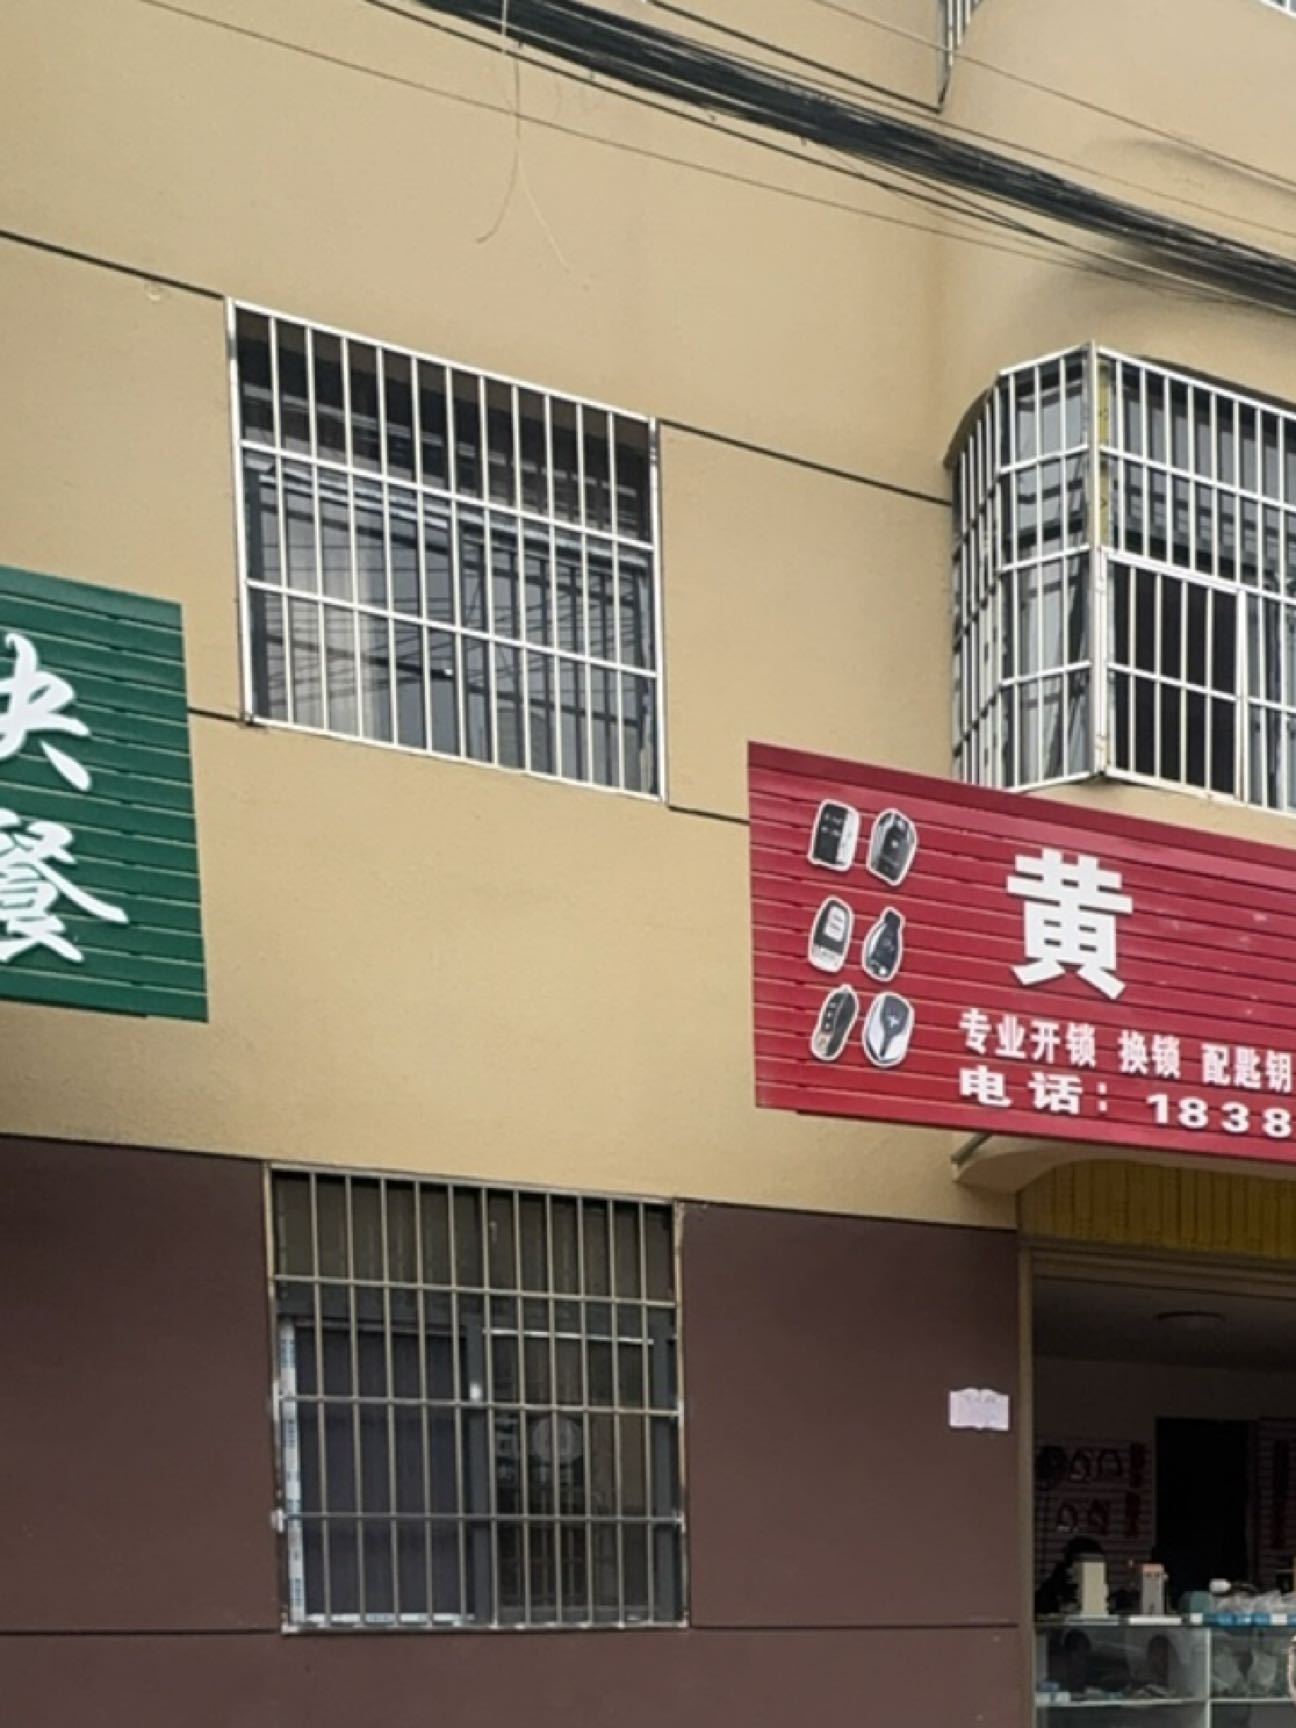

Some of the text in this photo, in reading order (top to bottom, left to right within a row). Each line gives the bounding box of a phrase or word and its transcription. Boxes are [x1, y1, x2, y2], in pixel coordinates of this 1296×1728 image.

[959, 1007, 1096, 1068] 专业开锁
[1119, 1029, 1181, 1079] 换锁
[1202, 1043, 1292, 1094] 配匙钥
